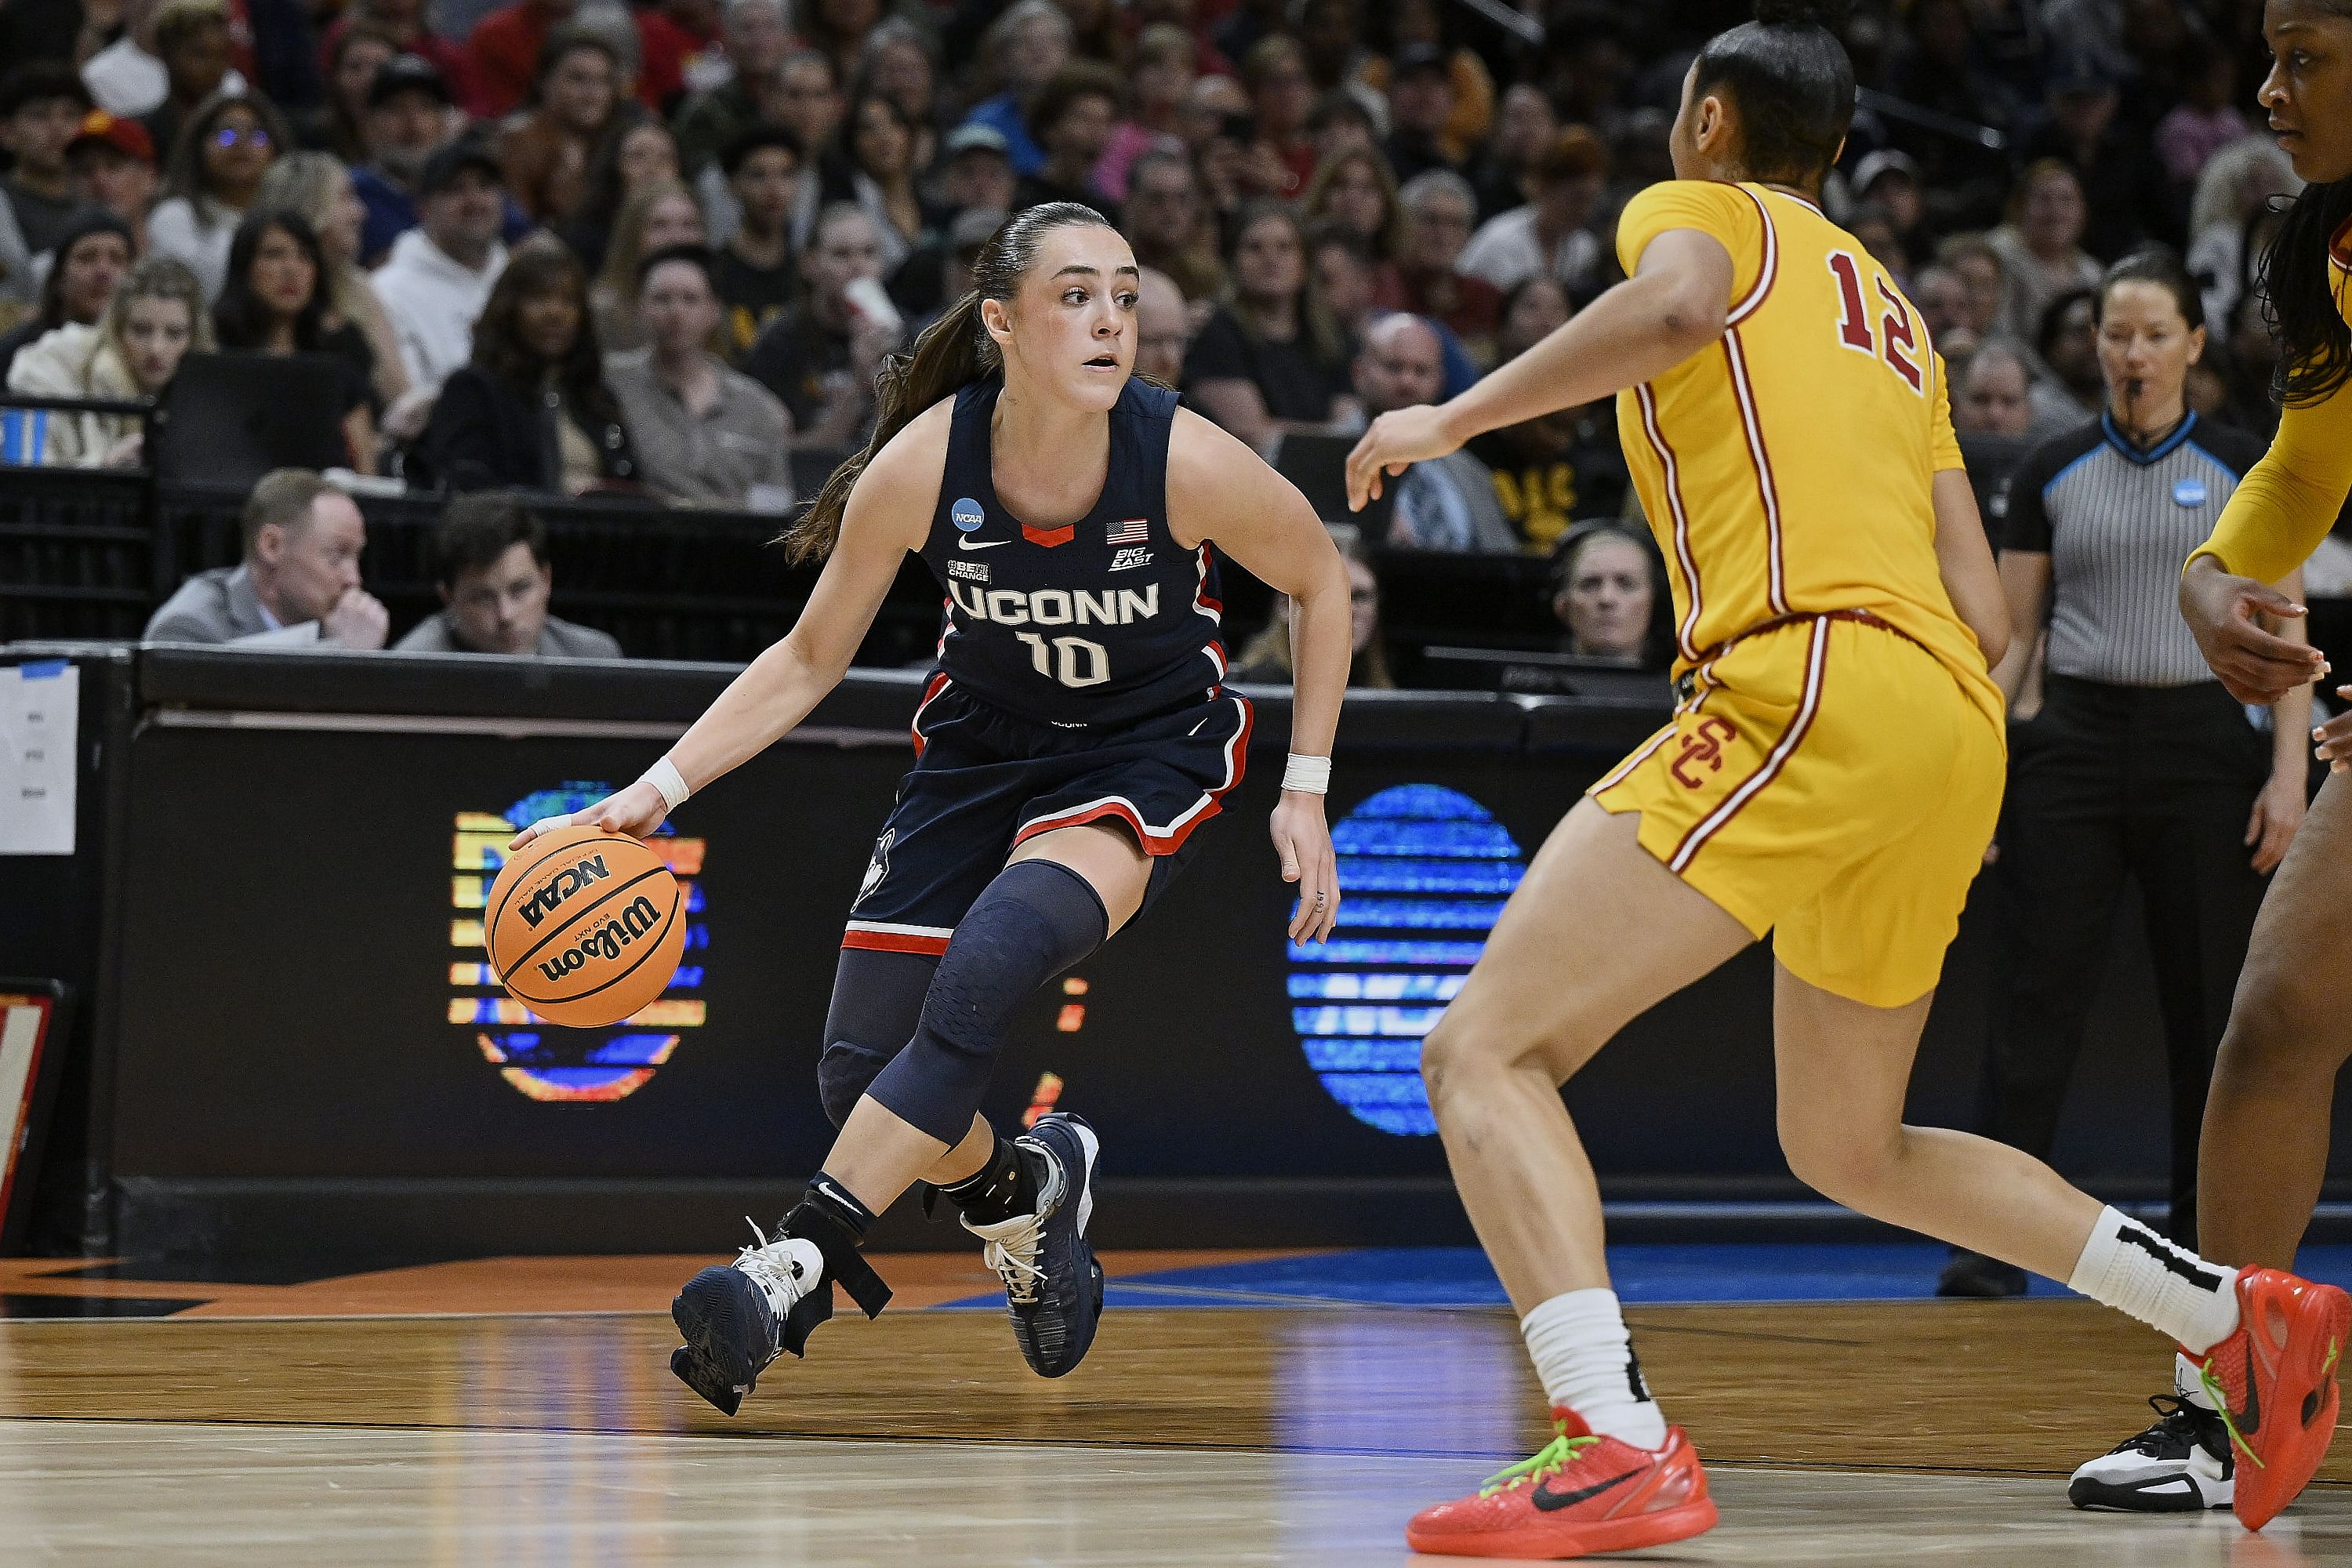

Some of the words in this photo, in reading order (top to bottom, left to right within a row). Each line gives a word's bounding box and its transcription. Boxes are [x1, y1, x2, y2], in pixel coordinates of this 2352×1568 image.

[1826, 249, 1925, 398] 12
[956, 513, 982, 524] NCAA
[1115, 546, 1146, 559] BIG
[1111, 553, 1155, 568] EAST
[949, 568, 989, 582] CHANGE
[947, 578, 1160, 626] UCONN
[1015, 630, 1111, 688] 10
[517, 855, 610, 928] NCAA
[593, 913, 611, 928] EVO
[537, 895, 662, 982] Wilson
[574, 927, 593, 942] NXT
